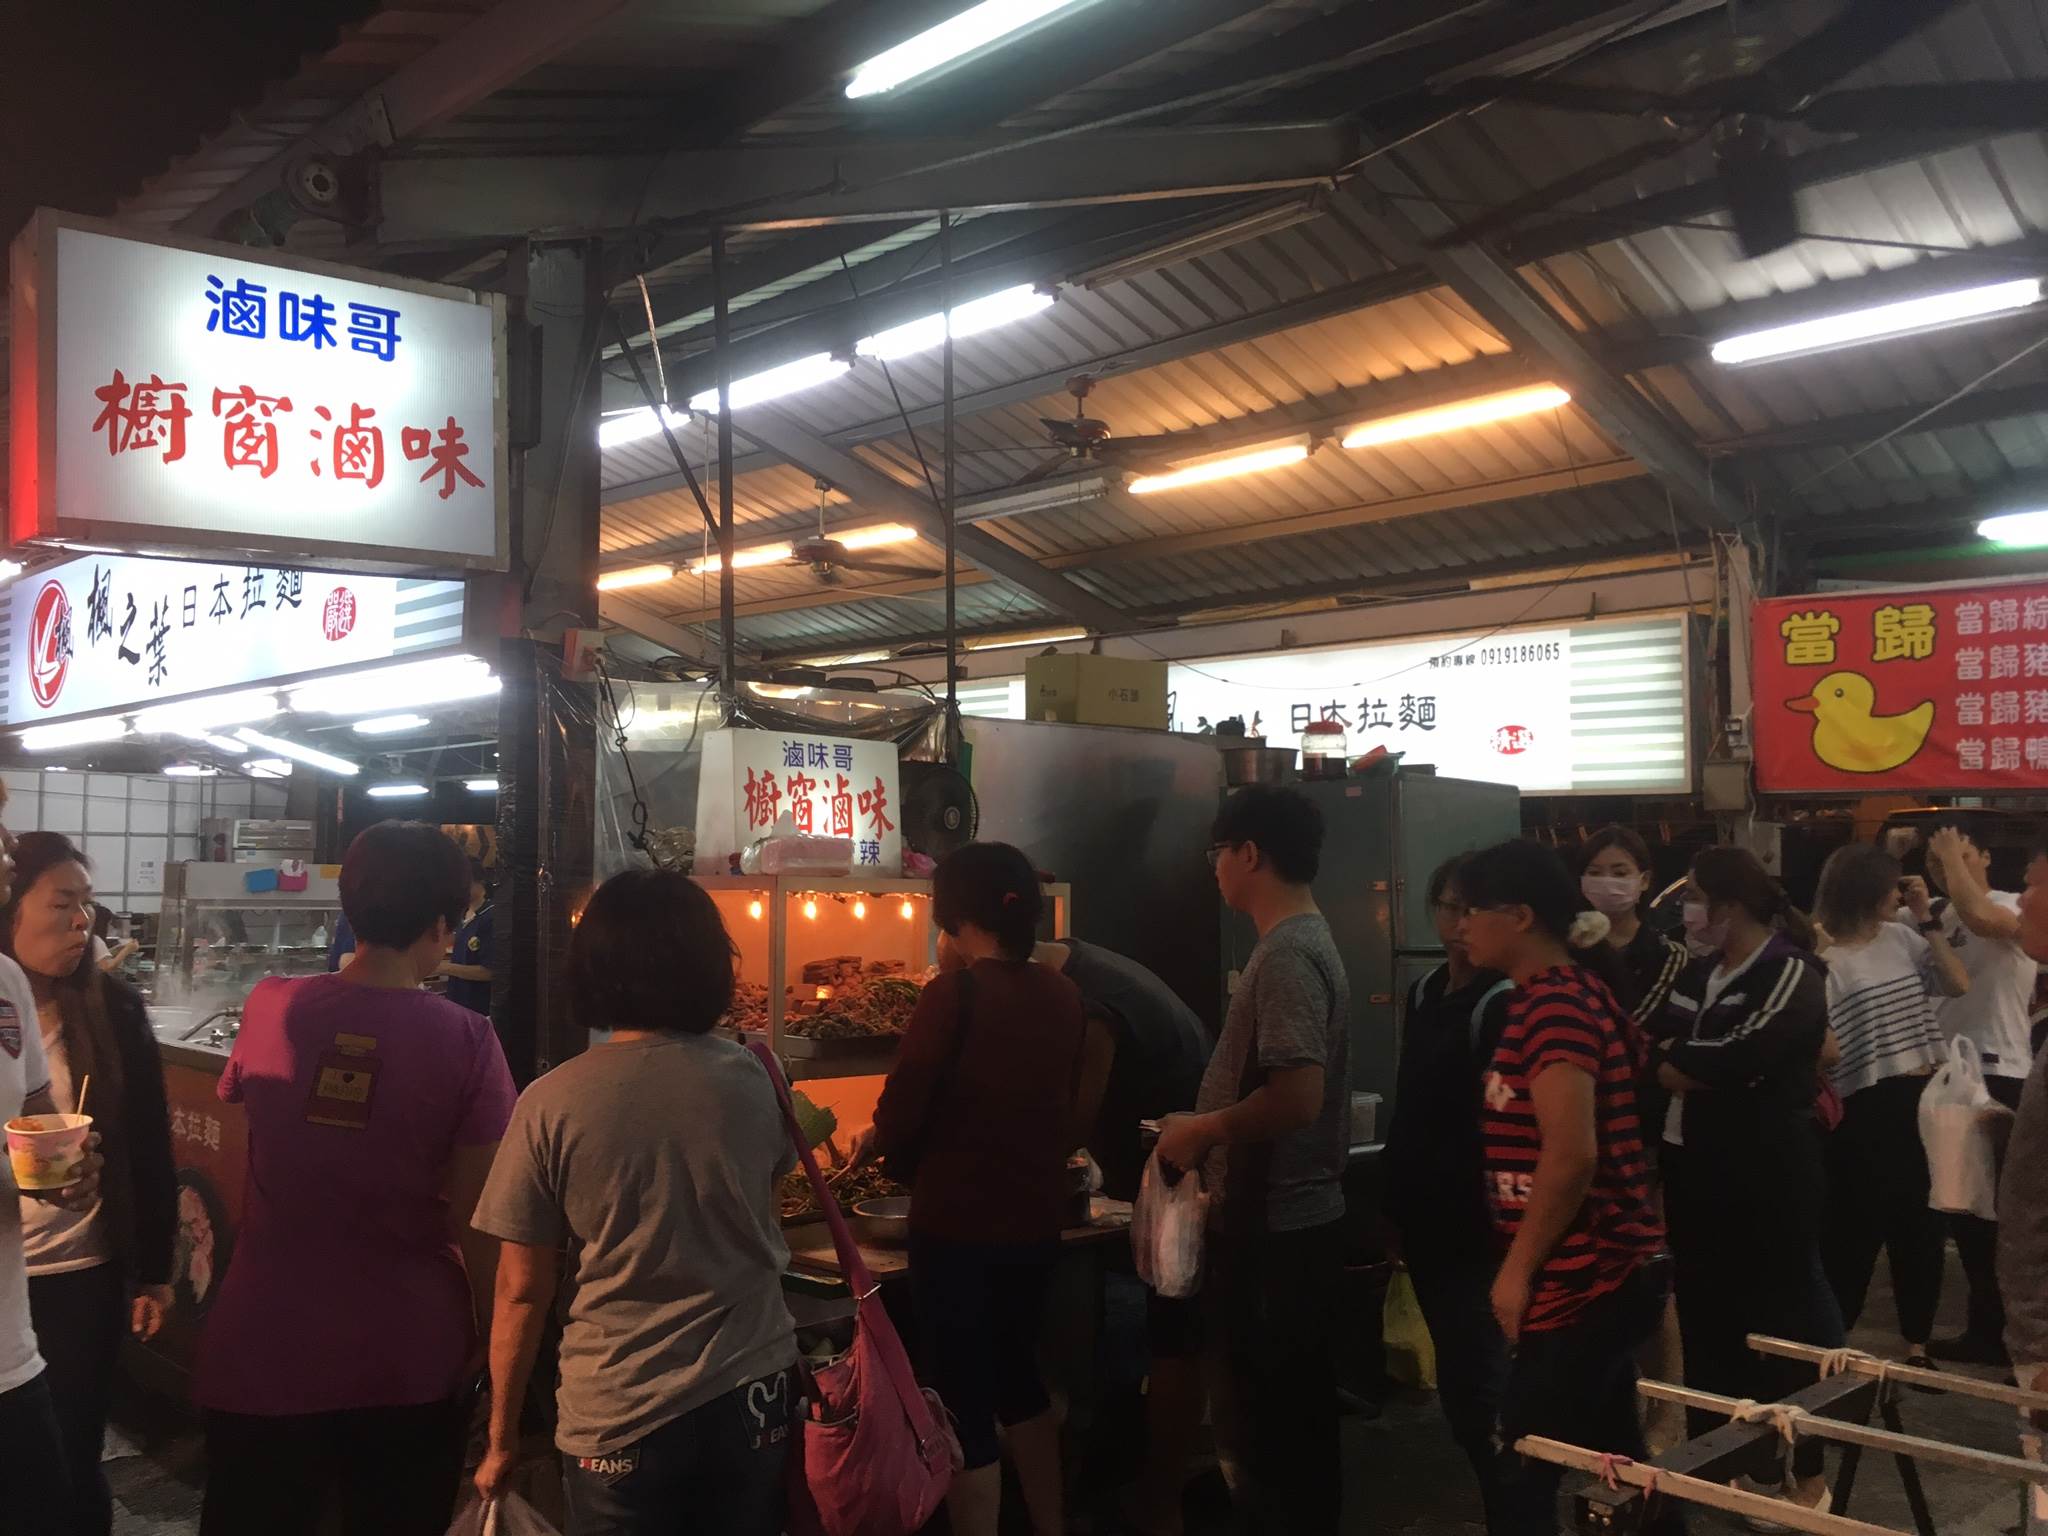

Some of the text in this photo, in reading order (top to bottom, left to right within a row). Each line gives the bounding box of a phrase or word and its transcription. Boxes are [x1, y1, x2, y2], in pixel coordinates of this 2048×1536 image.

[205, 274, 402, 362] 滷味哥
[92, 368, 486, 500] 櫥窗滷味
[87, 563, 303, 688] 楓之葉 日本拉麵
[1481, 642, 1560, 666] 0919186065
[1780, 603, 1937, 666] 當歸
[1291, 693, 1437, 734] 日本拉麵
[783, 740, 854, 772] 滷味哥
[743, 767, 895, 841] 櫥窗滷味
